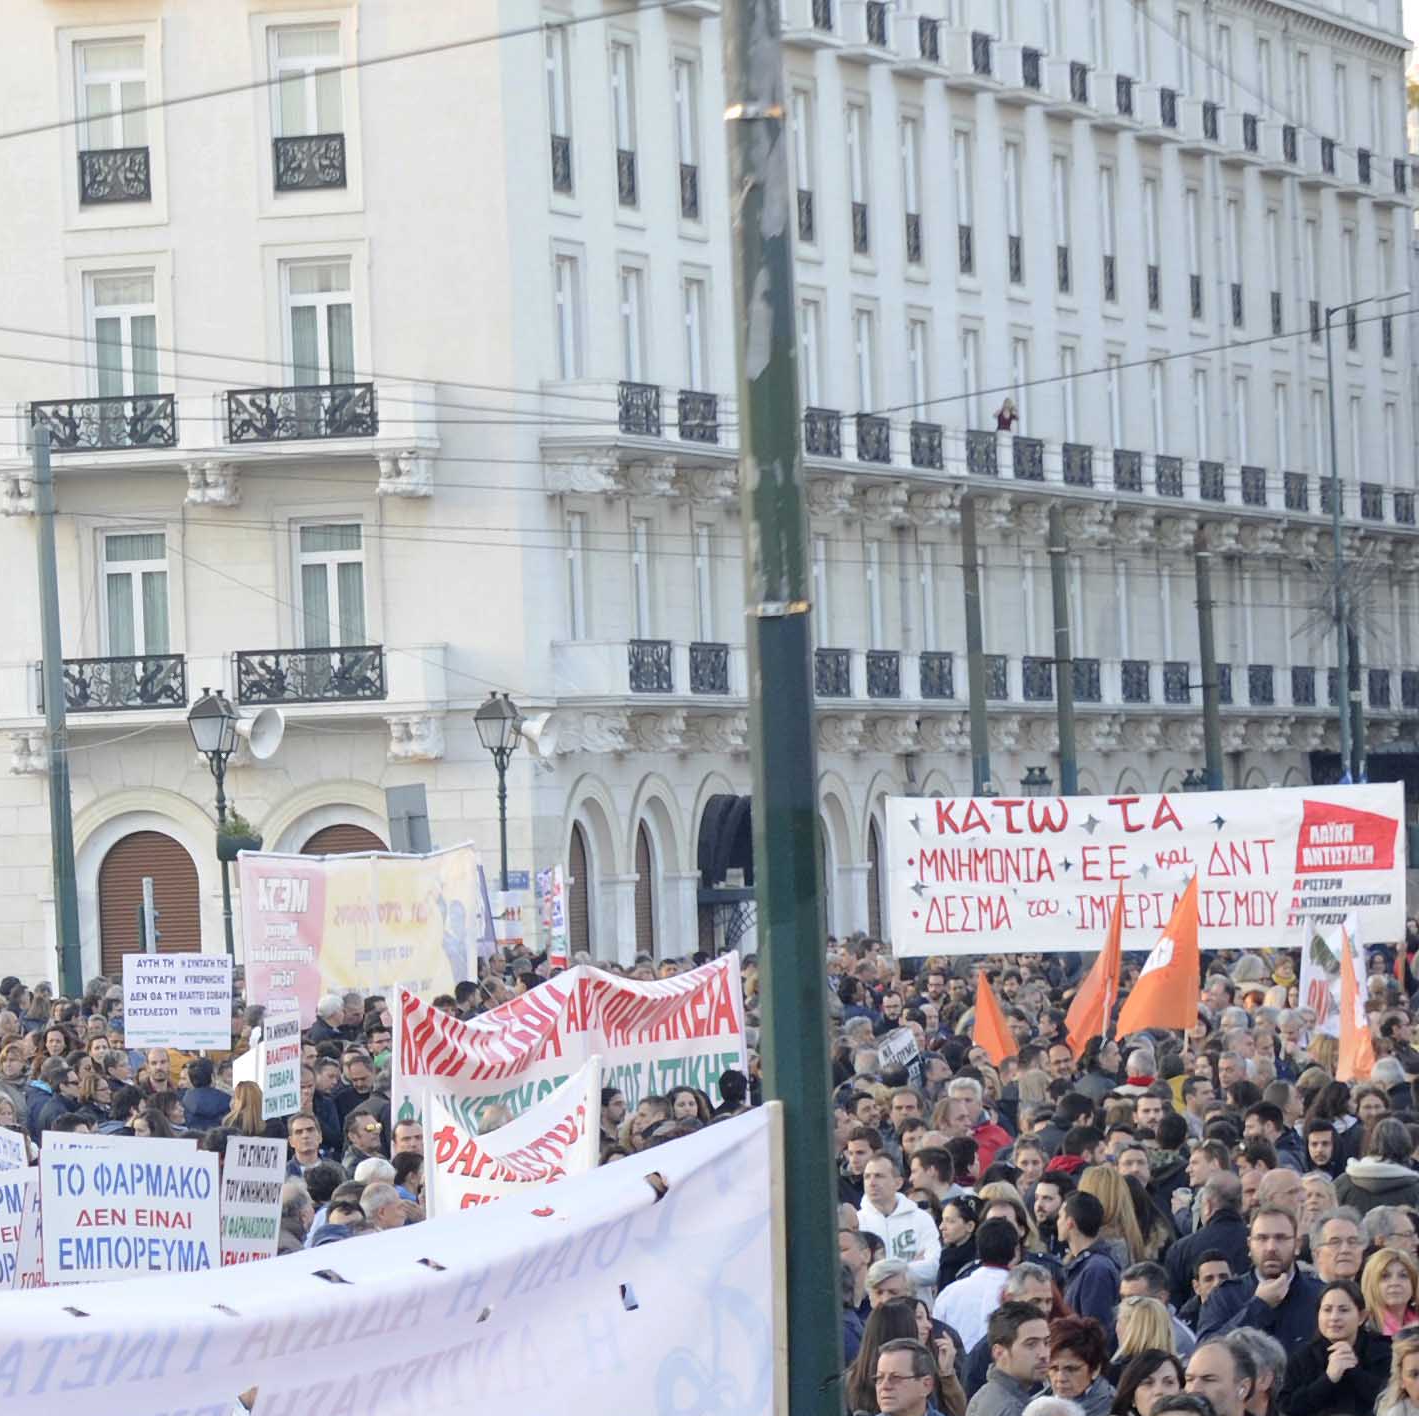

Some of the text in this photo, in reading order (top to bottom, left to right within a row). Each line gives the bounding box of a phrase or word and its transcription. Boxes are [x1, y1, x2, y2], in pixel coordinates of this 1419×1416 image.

[918, 846, 1055, 884] ΜΝΗΜΟΝΙΑ
[1081, 844, 1131, 881] ΕΕ
[1207, 838, 1276, 877] ΔΝΤ
[924, 894, 1013, 934] ΔΕΣΜΑ
[135, 975, 176, 985] ΣΥΝΤΑΓΗ
[51, 1161, 212, 1200] ΤΟ ΦΑΡΜΑΚΟ
[76, 1208, 193, 1230] ΔΕΝ ΕΙΝΑΙ
[58, 1236, 211, 1273] ΕΜΠΟΡΕΥΜΑ
